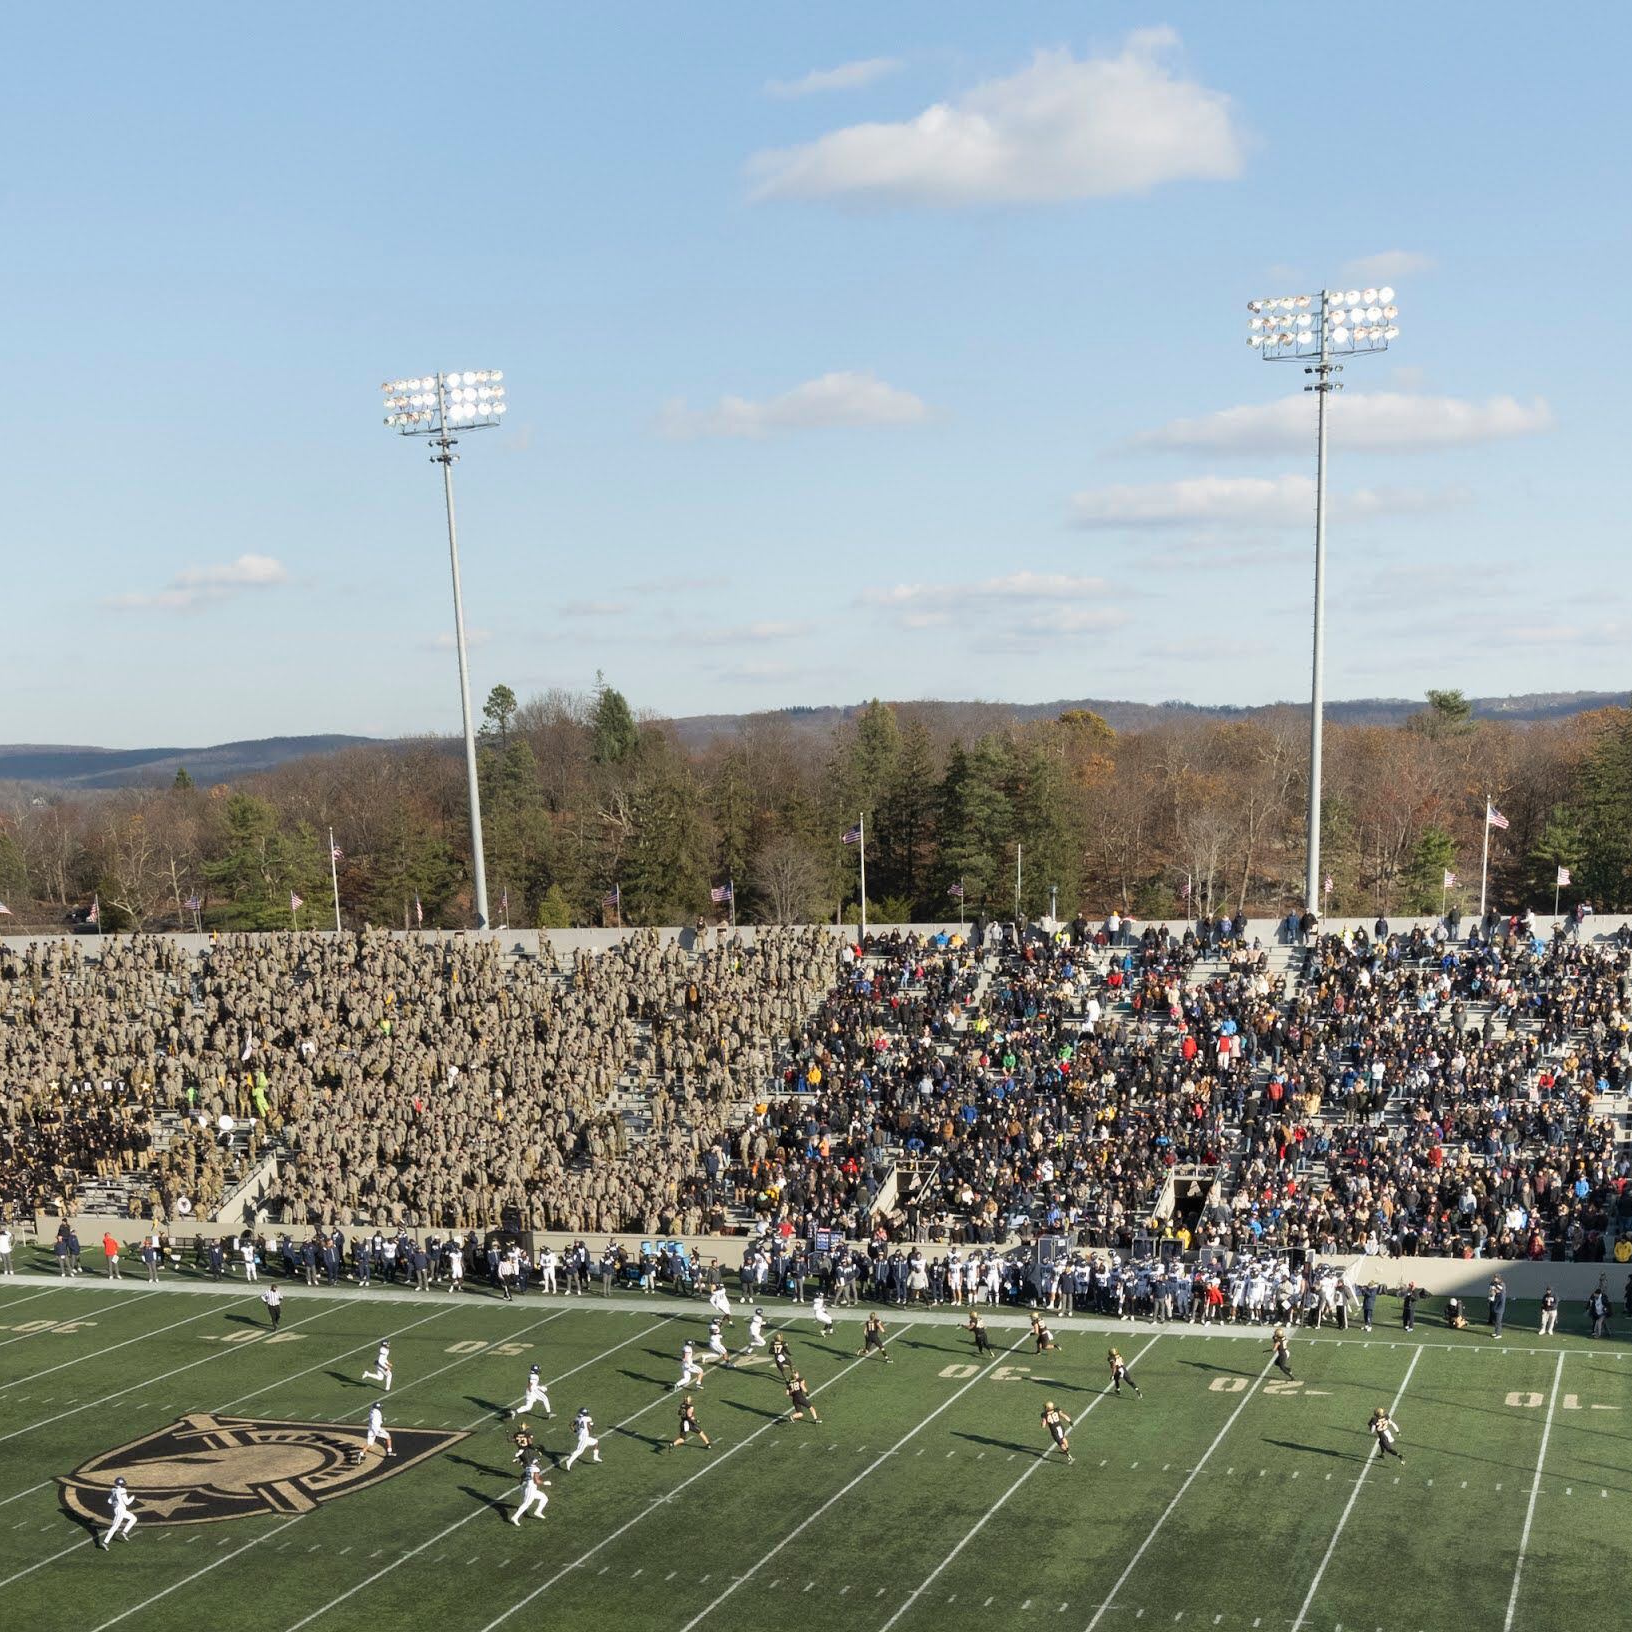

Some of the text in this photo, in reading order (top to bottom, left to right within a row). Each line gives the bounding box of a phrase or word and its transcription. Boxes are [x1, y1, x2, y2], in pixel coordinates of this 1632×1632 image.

[9, 1320, 98, 1334] 30
[219, 1329, 309, 1344] 40
[443, 1340, 534, 1356] 50
[938, 1364, 1032, 1381] 30
[1208, 1377, 1306, 1395] 20
[1504, 1391, 1593, 1410] 10
[1046, 1412, 1060, 1424] 48
